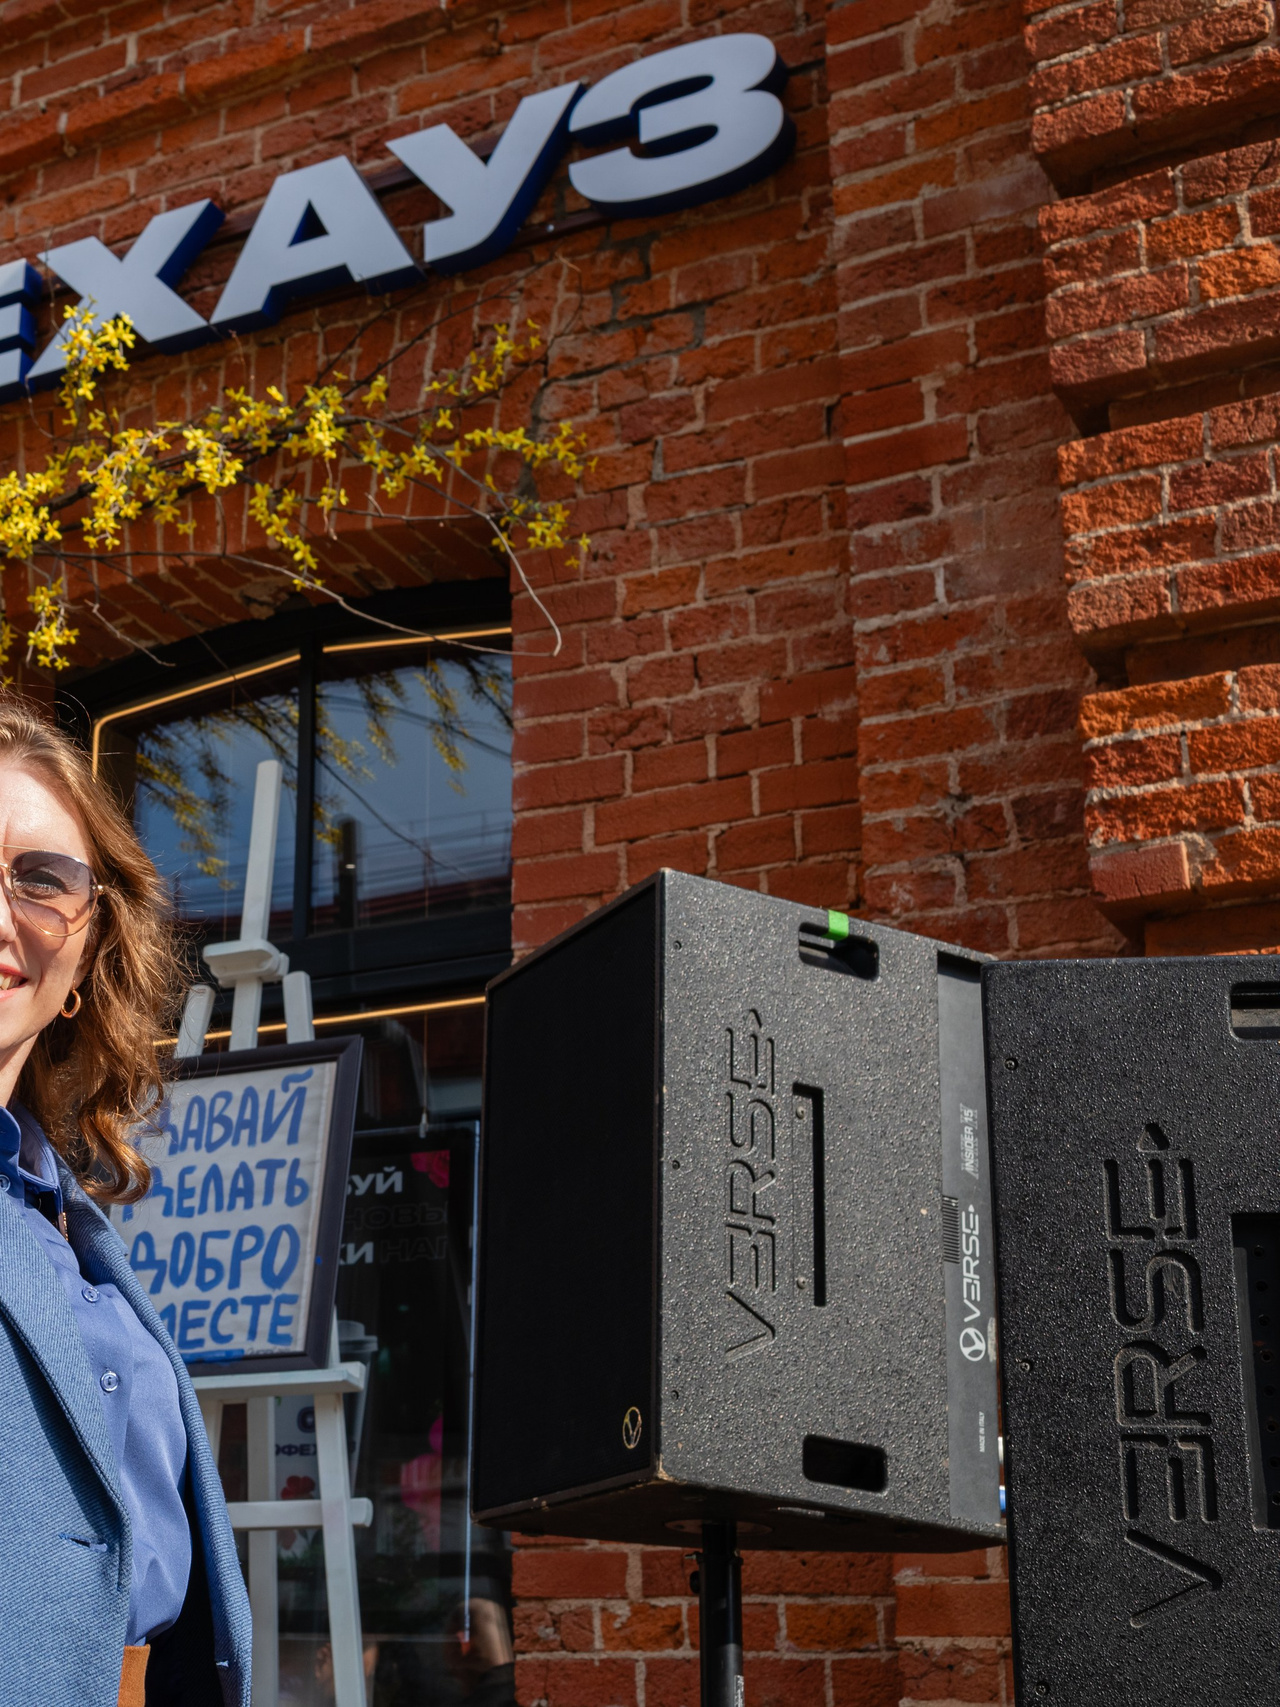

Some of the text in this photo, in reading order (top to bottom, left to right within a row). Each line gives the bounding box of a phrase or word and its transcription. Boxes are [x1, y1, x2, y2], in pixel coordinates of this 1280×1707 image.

[963, 1108, 975, 1171] INSIDER 15
[129, 1224, 301, 1295] ДОБРО
